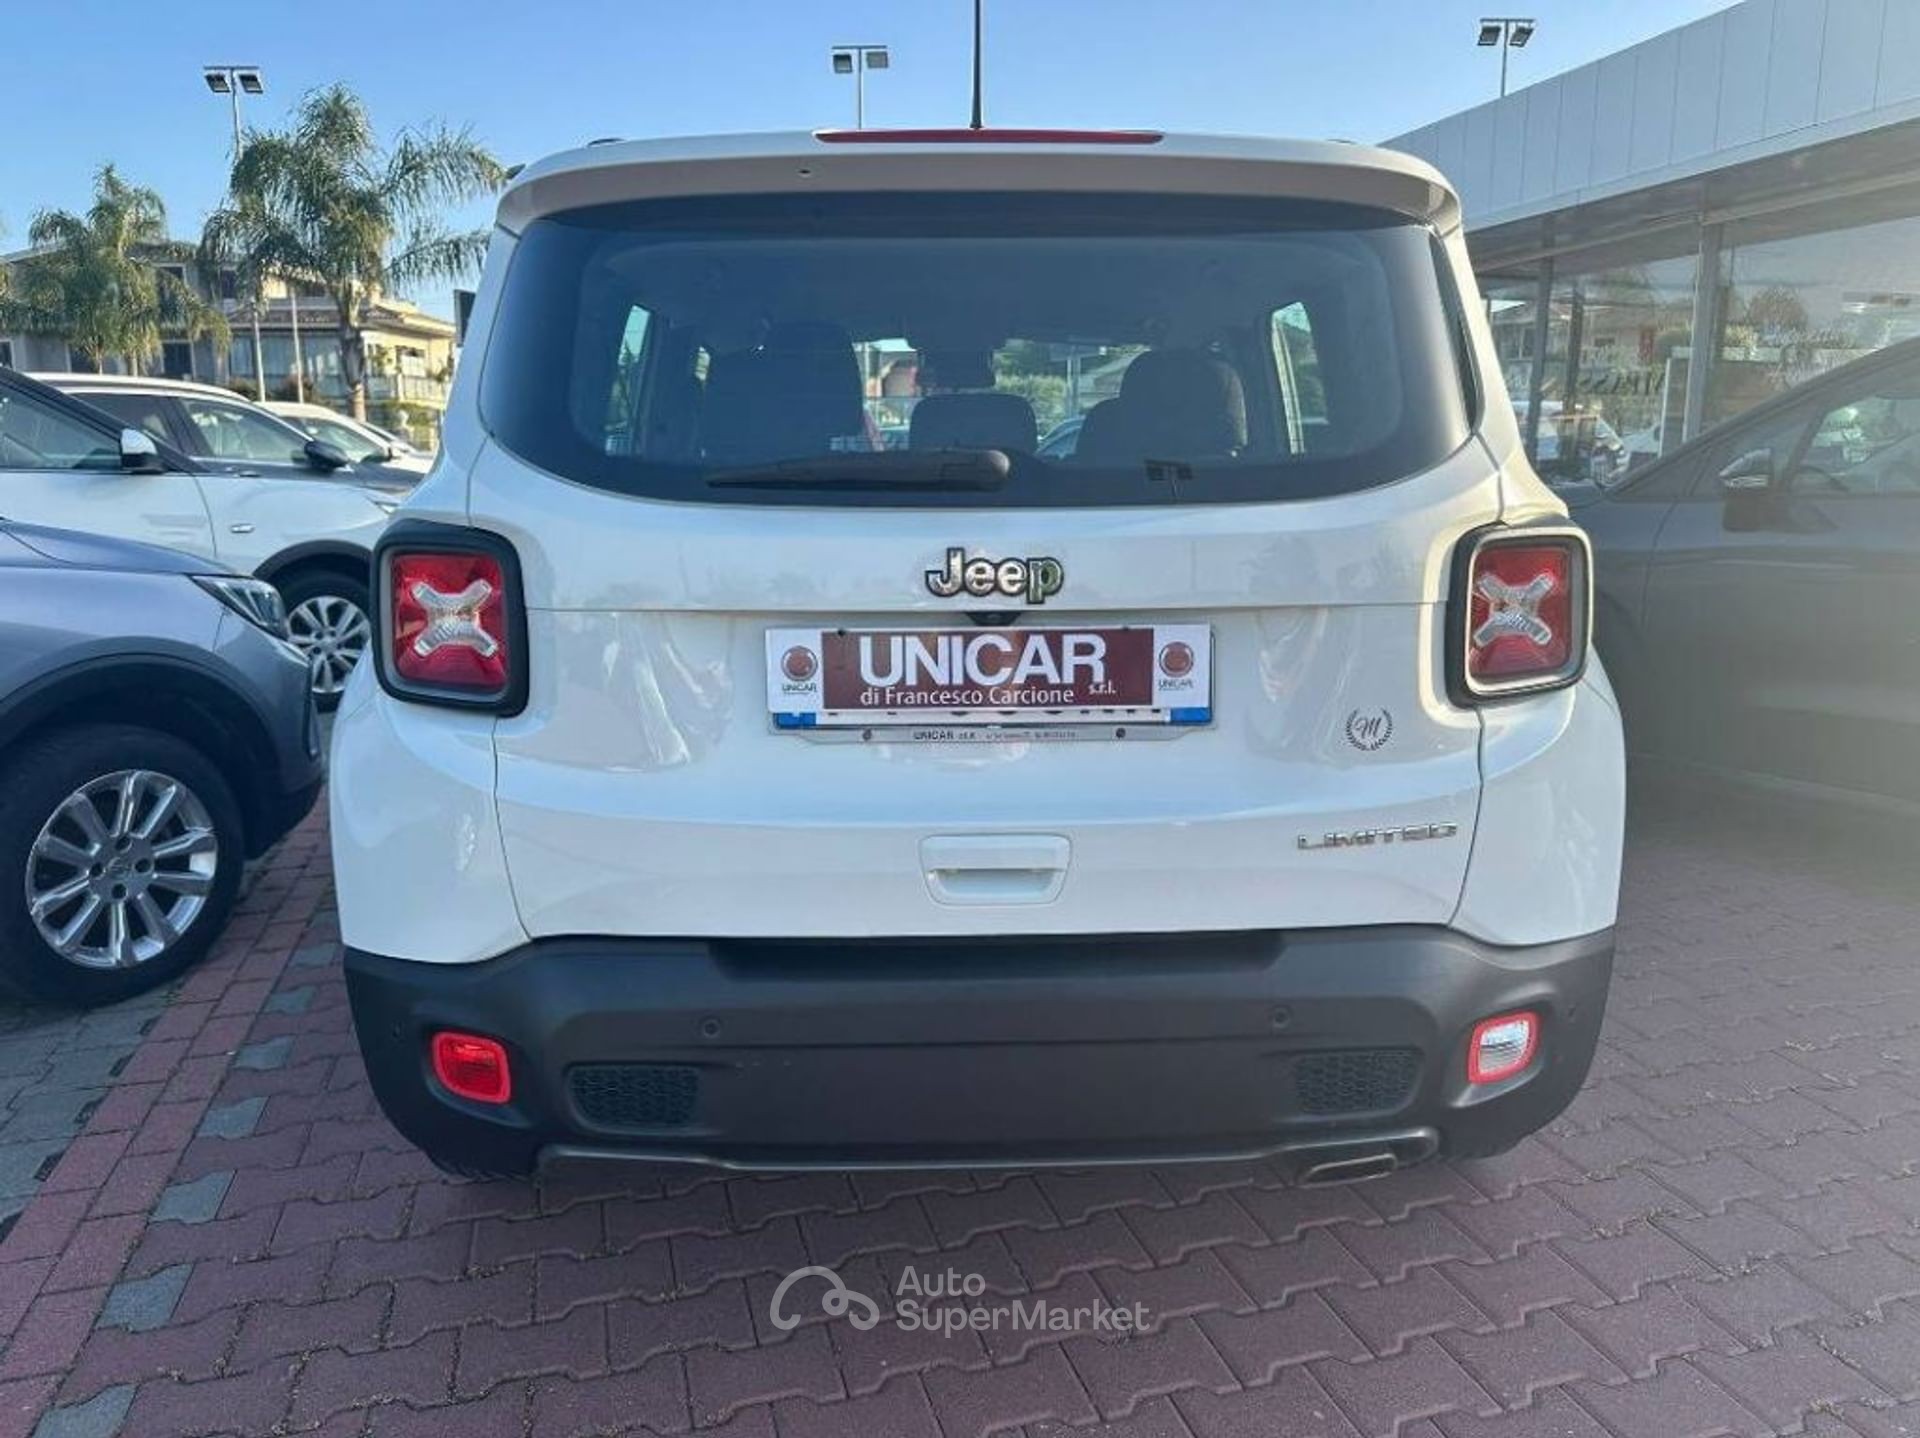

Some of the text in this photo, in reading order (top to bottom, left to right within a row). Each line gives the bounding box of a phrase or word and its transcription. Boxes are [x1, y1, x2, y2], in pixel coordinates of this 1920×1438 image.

[925, 548, 1065, 604] Jeep
[859, 633, 1107, 688] UNICAR
[860, 686, 1075, 706] di Francesco Carcione
[1297, 822, 1458, 850] LIMITED
